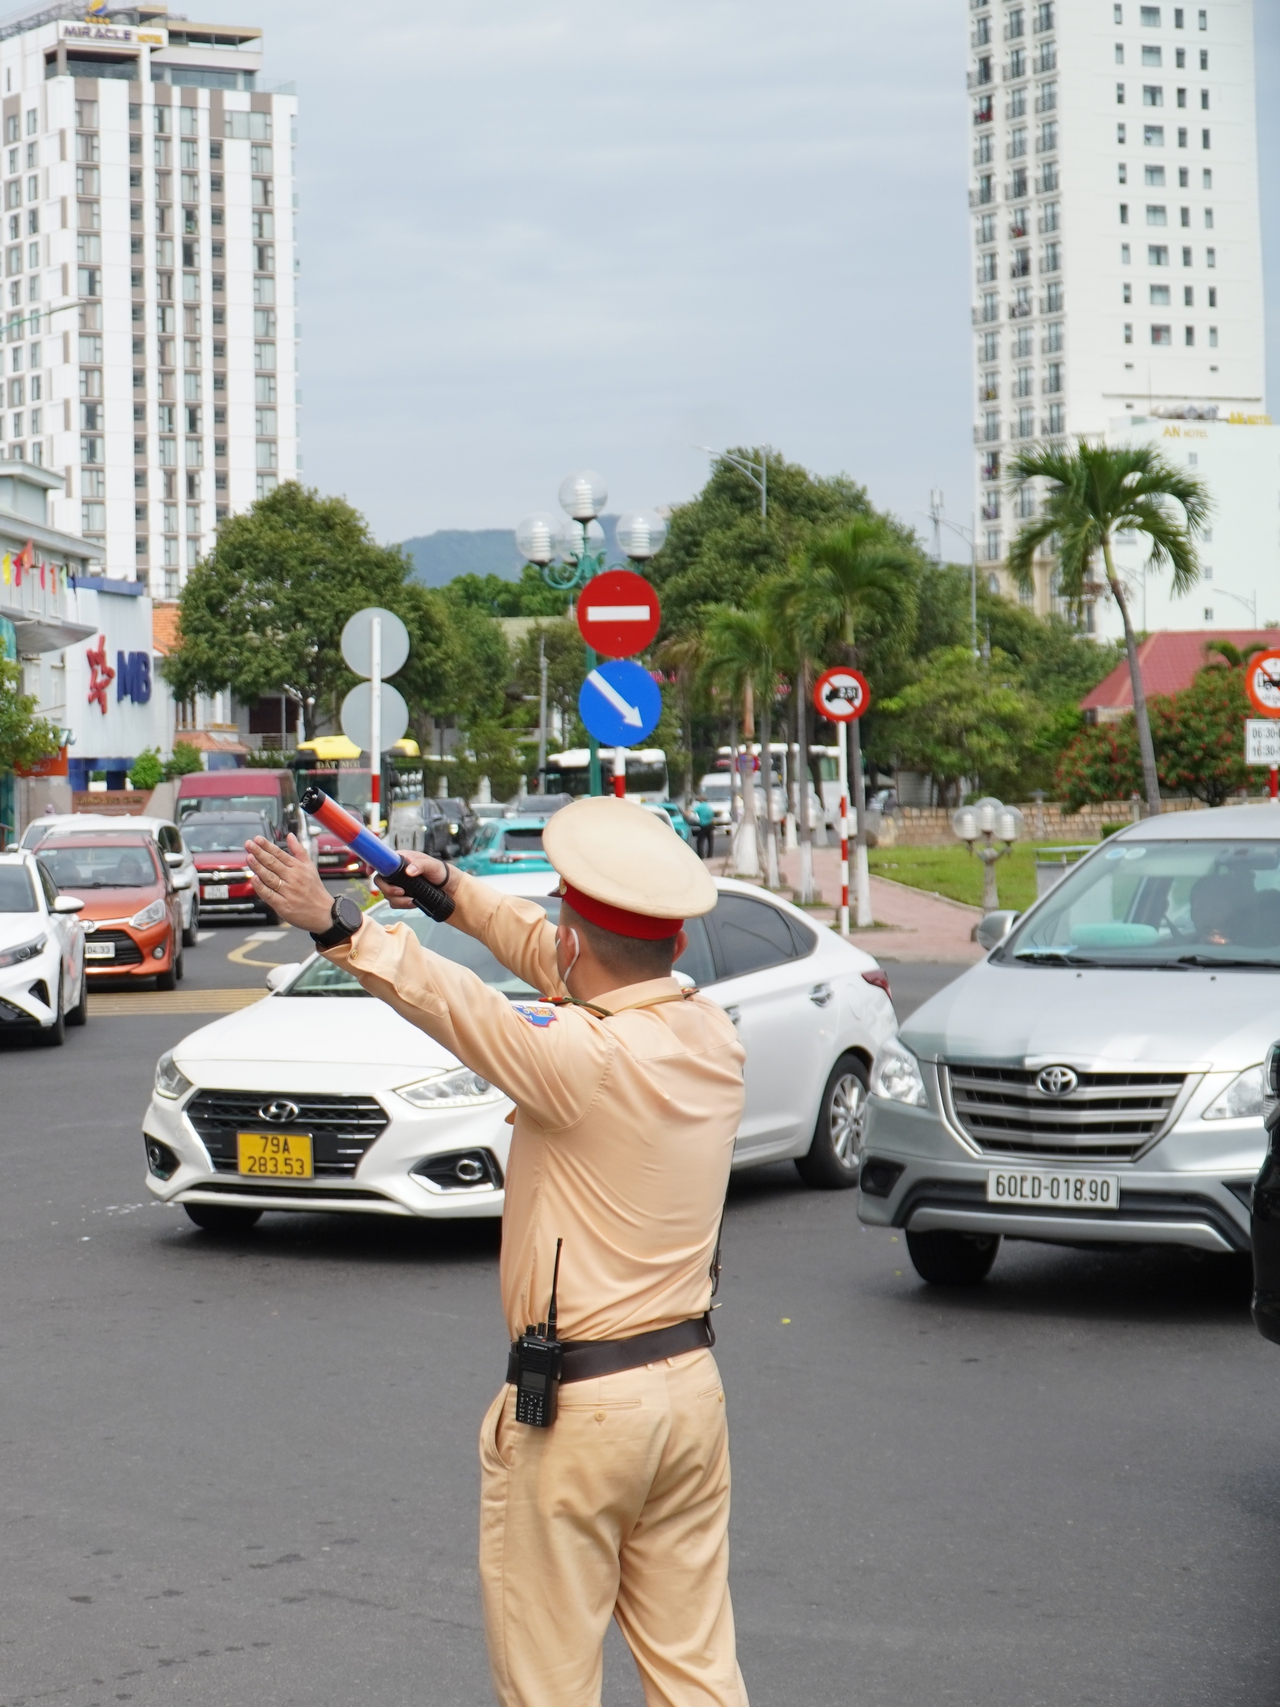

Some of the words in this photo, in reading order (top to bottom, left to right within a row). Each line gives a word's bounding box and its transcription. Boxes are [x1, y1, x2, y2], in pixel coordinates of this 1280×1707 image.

[64, 26, 132, 40] MIRACLE
[1163, 425, 1181, 437] AN
[1183, 429, 1208, 438] HOTEL
[117, 650, 152, 705] MB
[260, 1135, 291, 1154] 79A
[248, 1156, 305, 1175] 283.53
[995, 1174, 1111, 1202] 60LD-018.90
